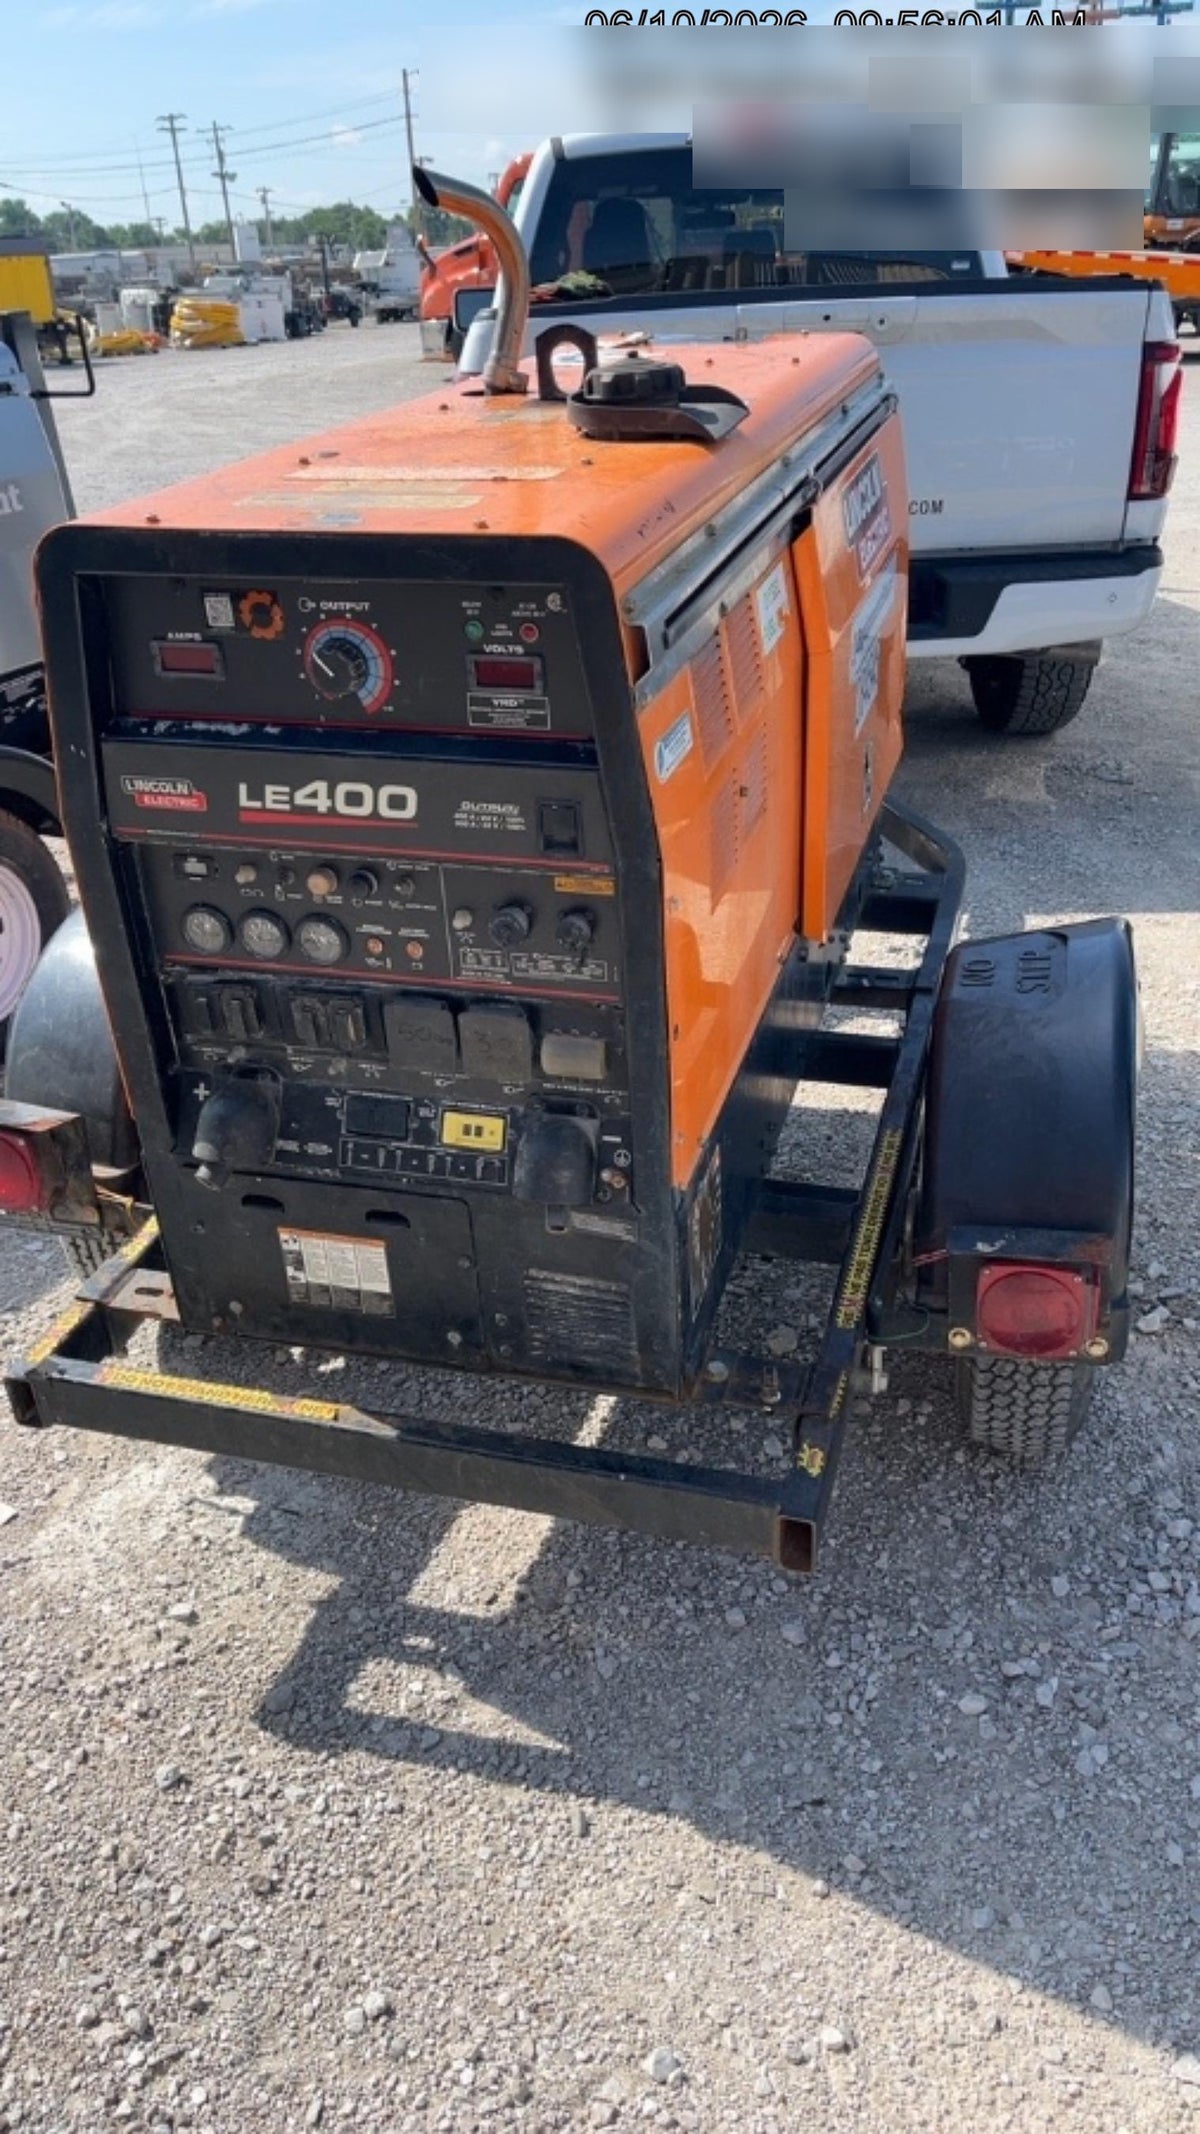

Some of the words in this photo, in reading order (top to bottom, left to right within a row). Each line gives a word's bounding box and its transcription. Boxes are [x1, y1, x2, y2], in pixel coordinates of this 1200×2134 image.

[319, 601, 371, 612] OUTPUT
[483, 643, 525, 656] VOLTS
[125, 778, 190, 796] LINCOLN
[239, 780, 418, 819] LE400
